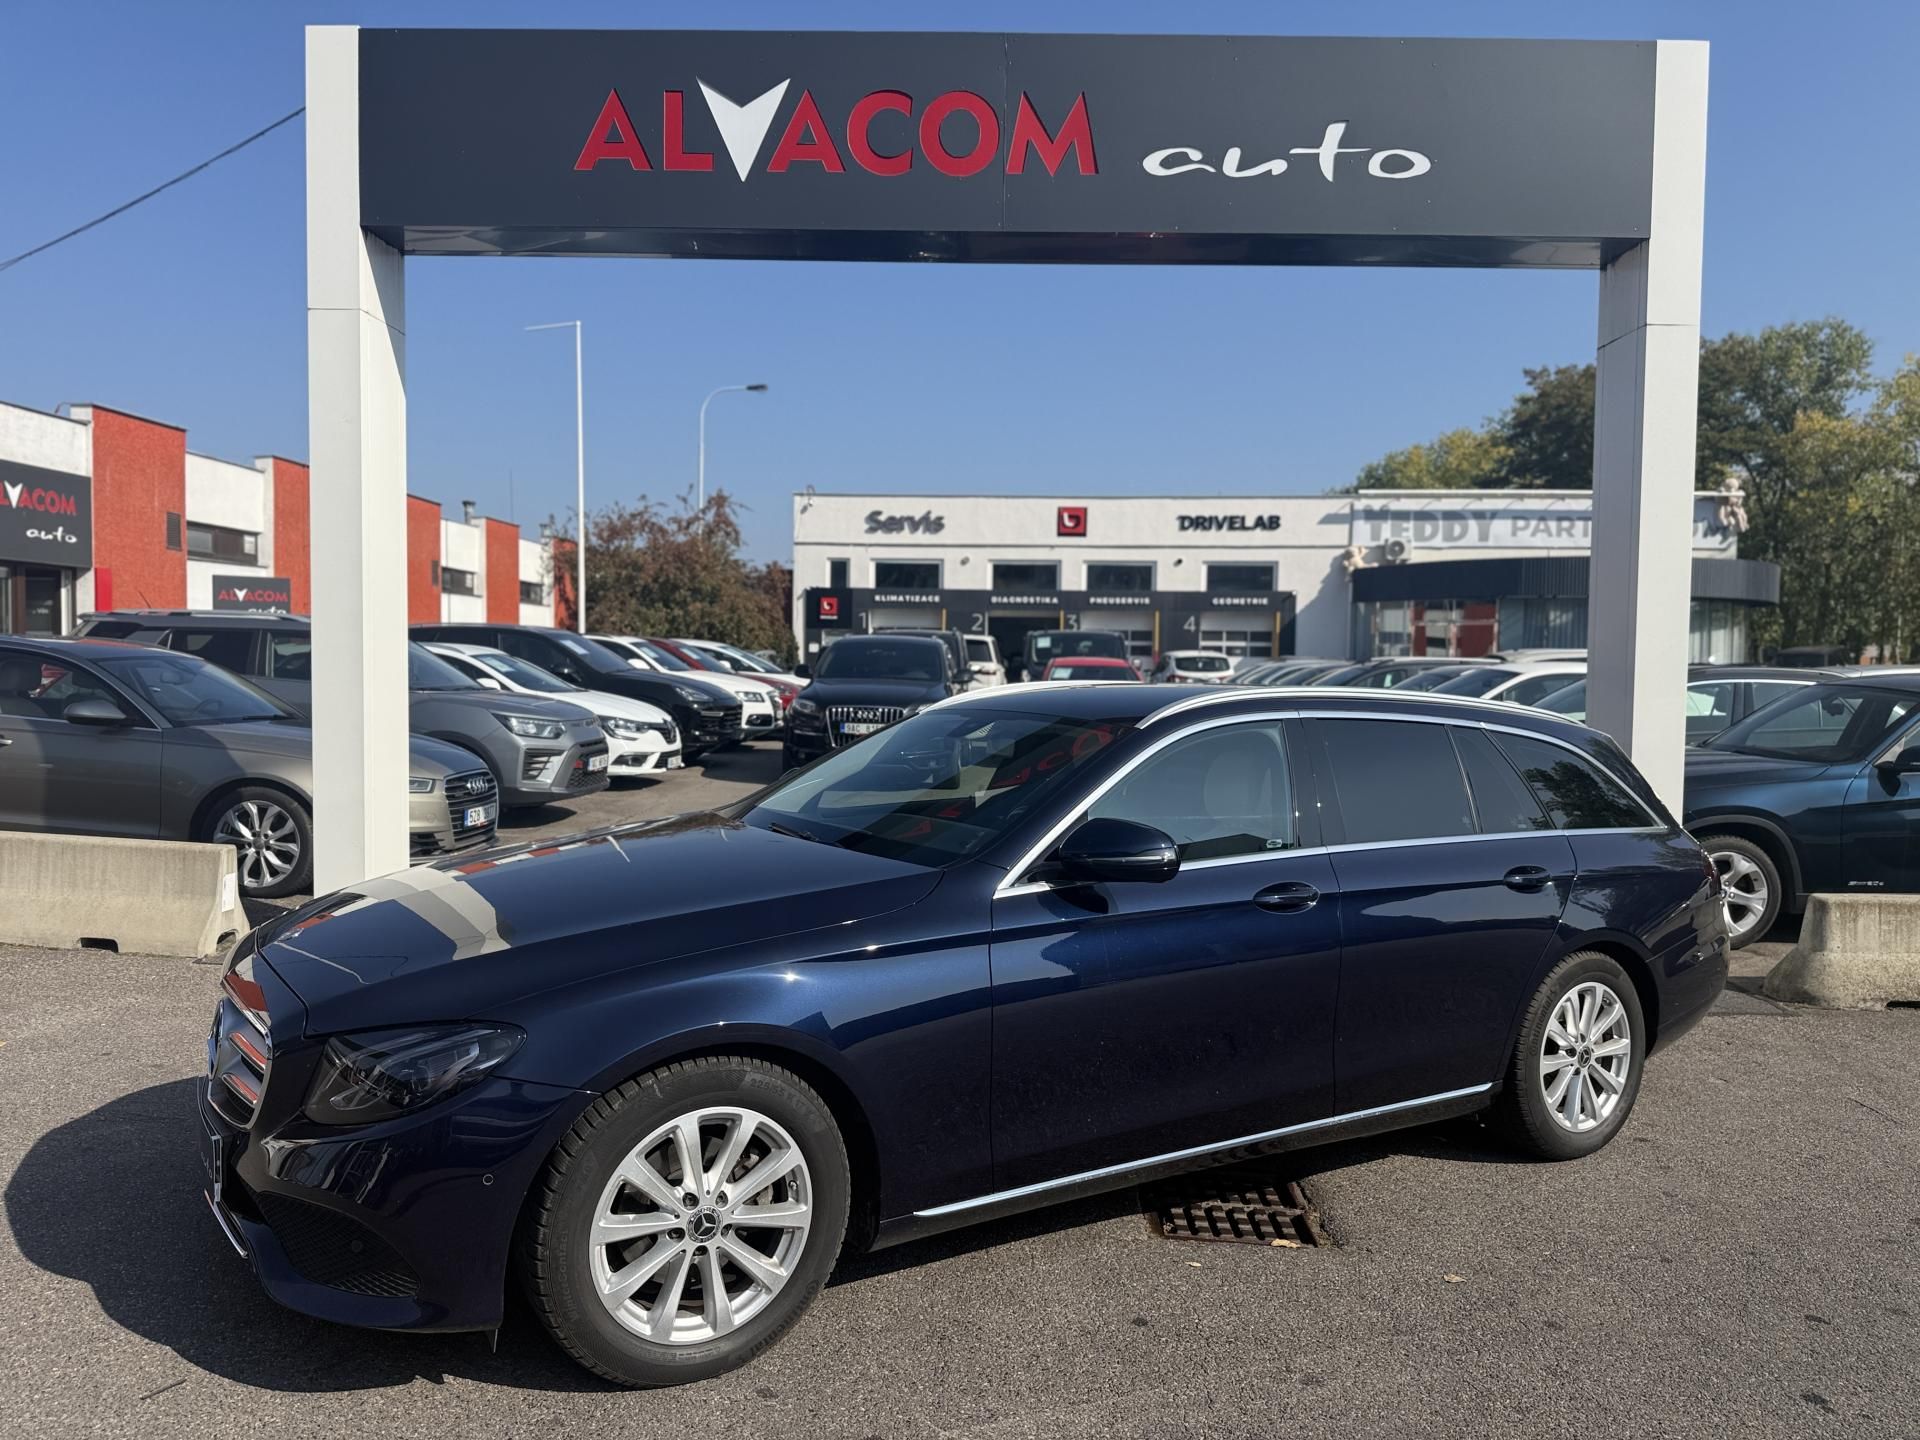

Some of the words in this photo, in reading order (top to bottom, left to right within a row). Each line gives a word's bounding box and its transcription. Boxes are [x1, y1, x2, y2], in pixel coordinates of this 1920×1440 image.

[574, 76, 1099, 182] ALVACOM
[1143, 120, 1431, 182] auto
[0, 480, 77, 516] LVACOM
[864, 510, 945, 534] Servis
[1177, 515, 1281, 532] DRIVELAB
[1362, 506, 1498, 543] TEDDY
[26, 526, 77, 543] auto
[218, 588, 288, 602] ALVACOM
[874, 594, 941, 603] KLIMATIZACE
[990, 596, 1059, 604] DIAGNOSTIKA
[1089, 596, 1150, 605] PNEUSERVIS
[1212, 597, 1269, 605] GEOMETRIE
[858, 612, 867, 628] 1
[971, 613, 984, 631] 2
[1066, 614, 1078, 631] 3
[1183, 615, 1196, 632] 4
